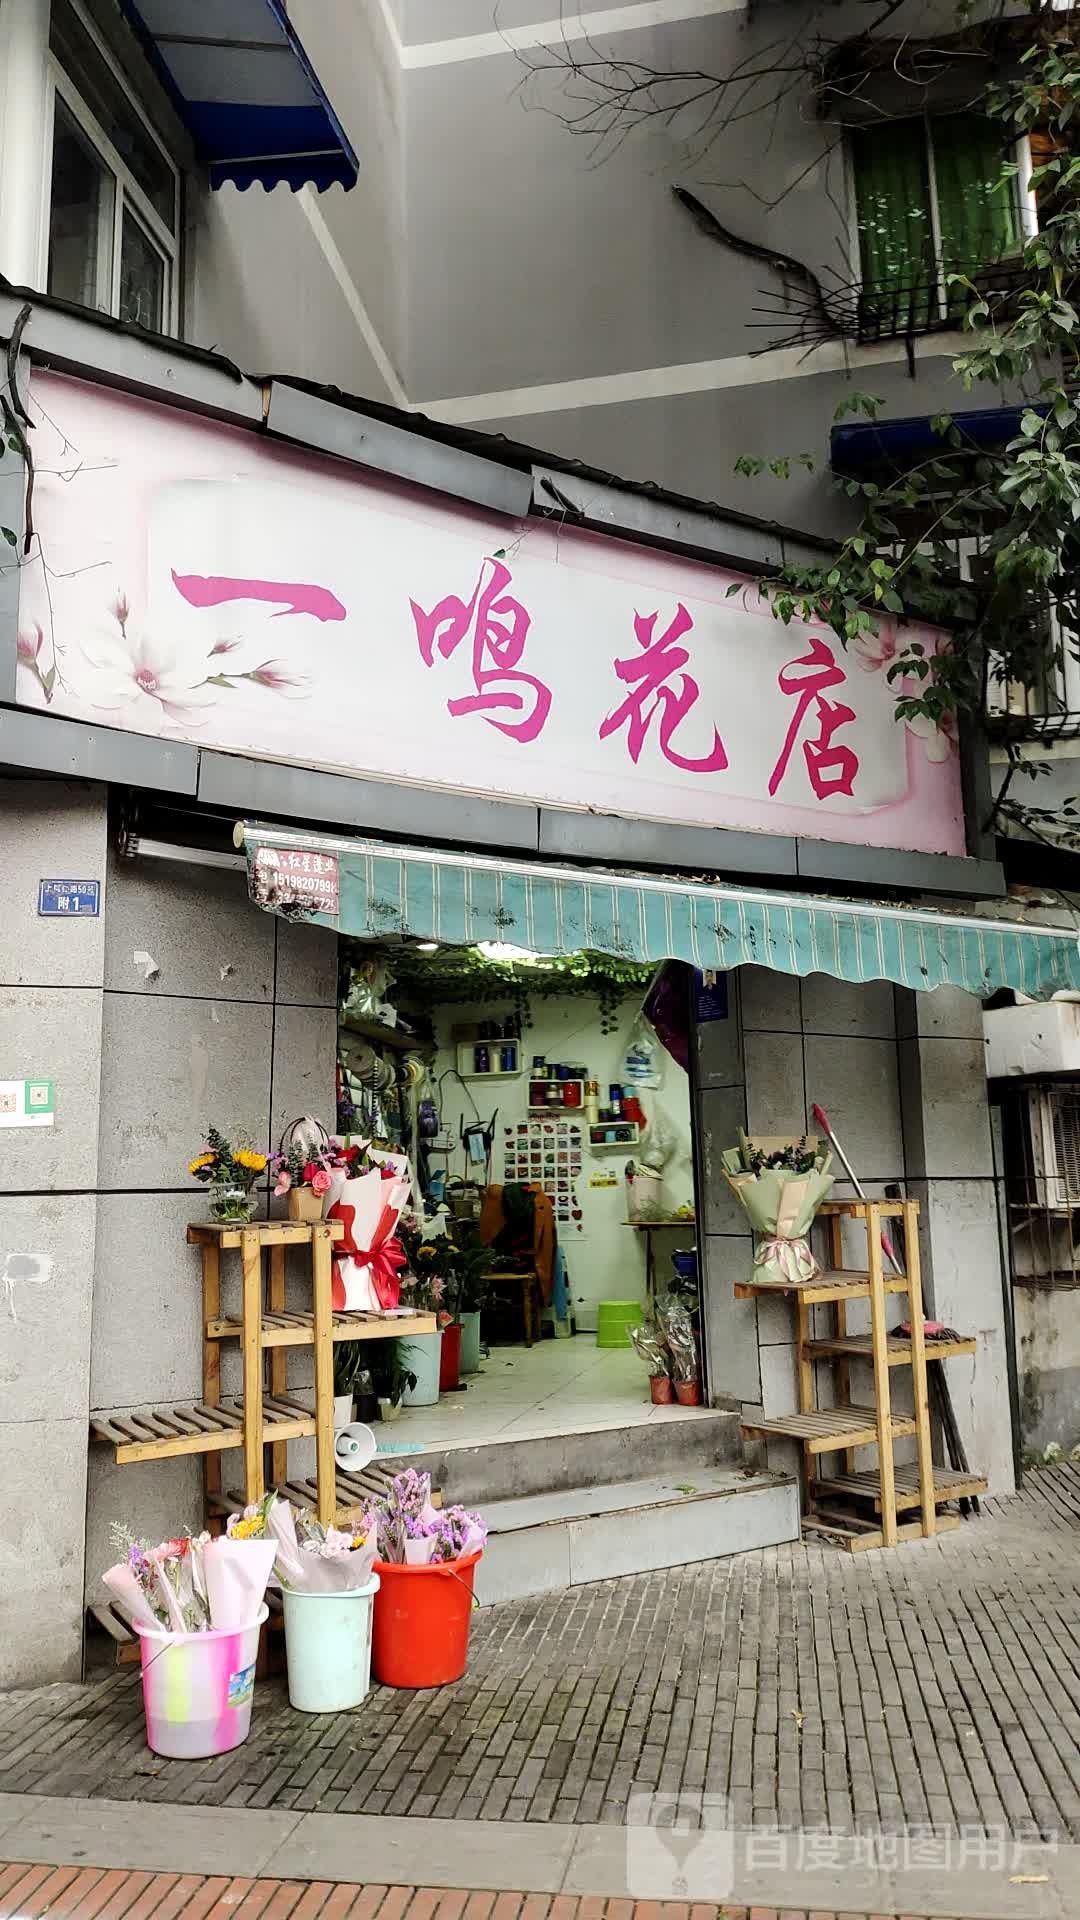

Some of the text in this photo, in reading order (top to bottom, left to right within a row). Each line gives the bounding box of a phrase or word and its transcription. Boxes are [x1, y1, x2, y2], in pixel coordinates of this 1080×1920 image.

[171, 556, 858, 800] 一鸣花店
[57, 896, 80, 911] 附1
